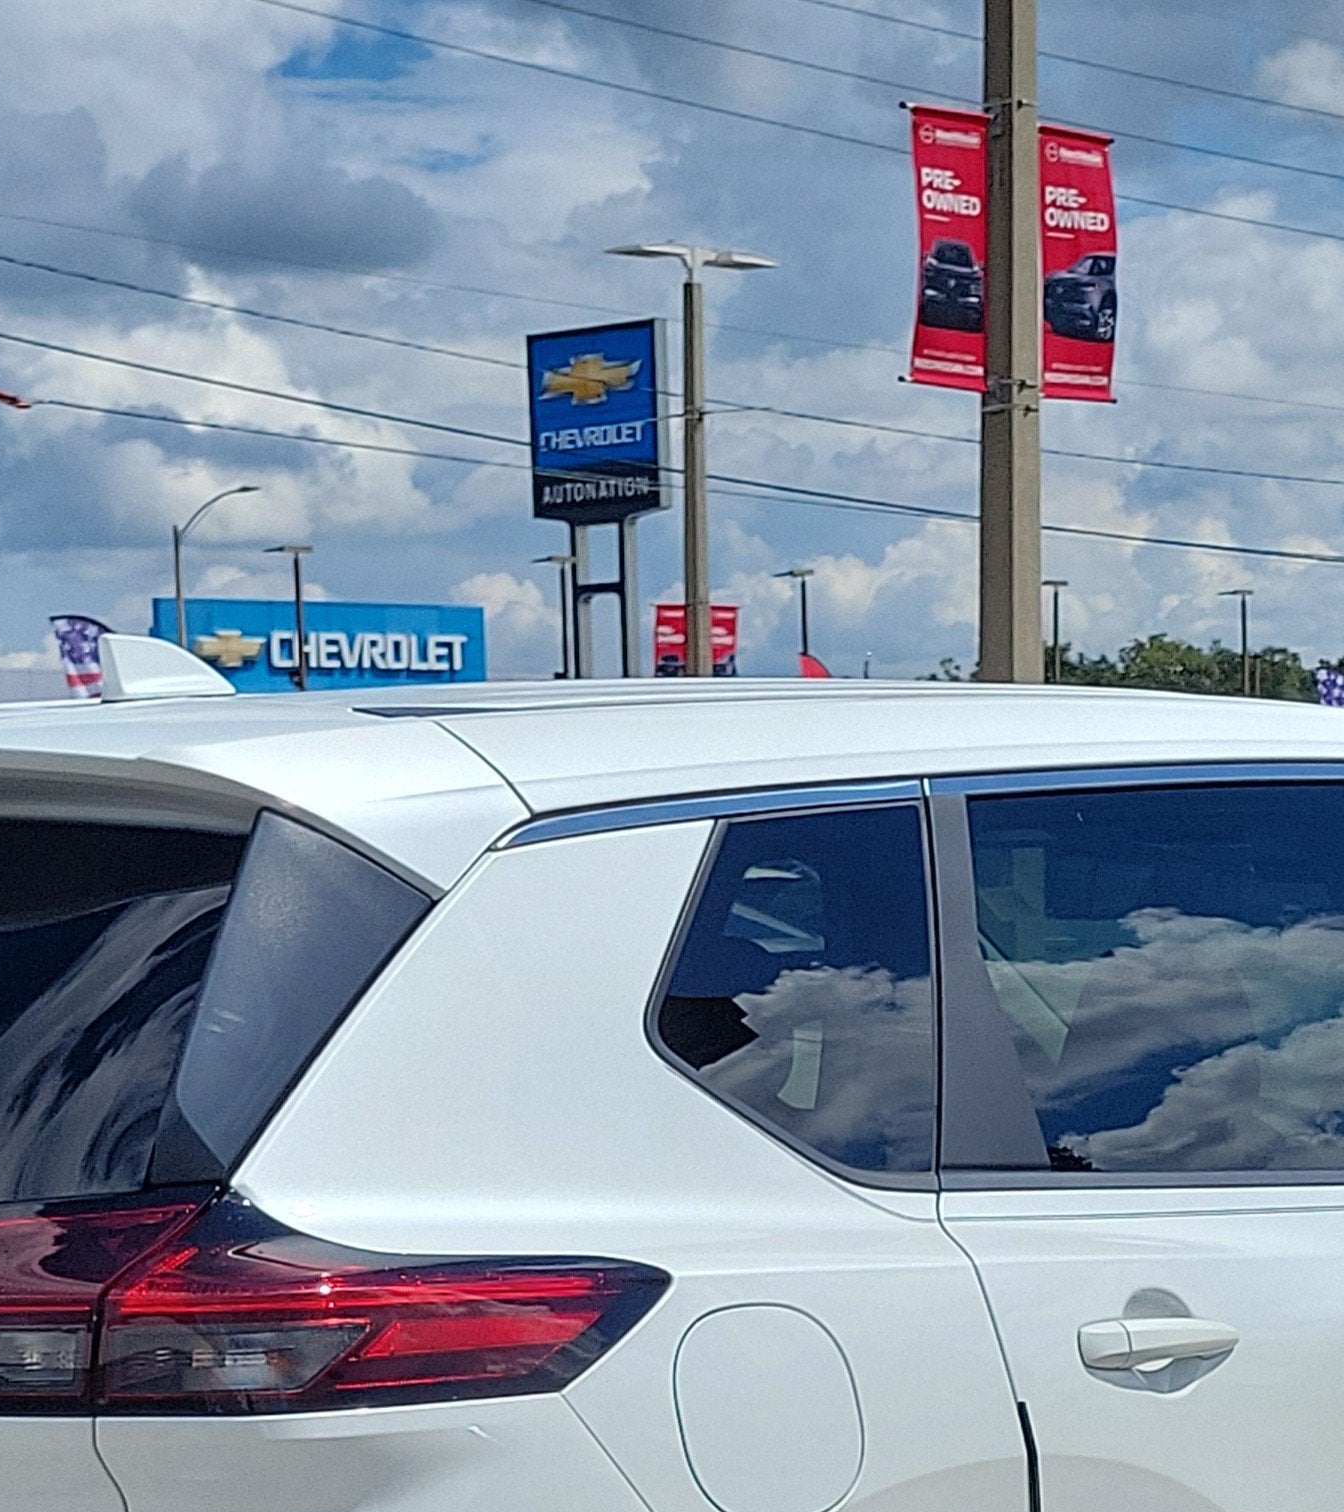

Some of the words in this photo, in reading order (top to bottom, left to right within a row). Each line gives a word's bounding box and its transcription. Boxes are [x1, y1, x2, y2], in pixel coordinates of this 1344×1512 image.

[920, 166, 963, 191] PRE-
[921, 187, 982, 217] OWNED
[1044, 185, 1088, 209] PRE-
[1044, 205, 1111, 233] OWNED
[539, 420, 645, 452] CHEVROLET
[542, 475, 651, 505] AUTONATION
[270, 629, 469, 672] CHEVROLET
